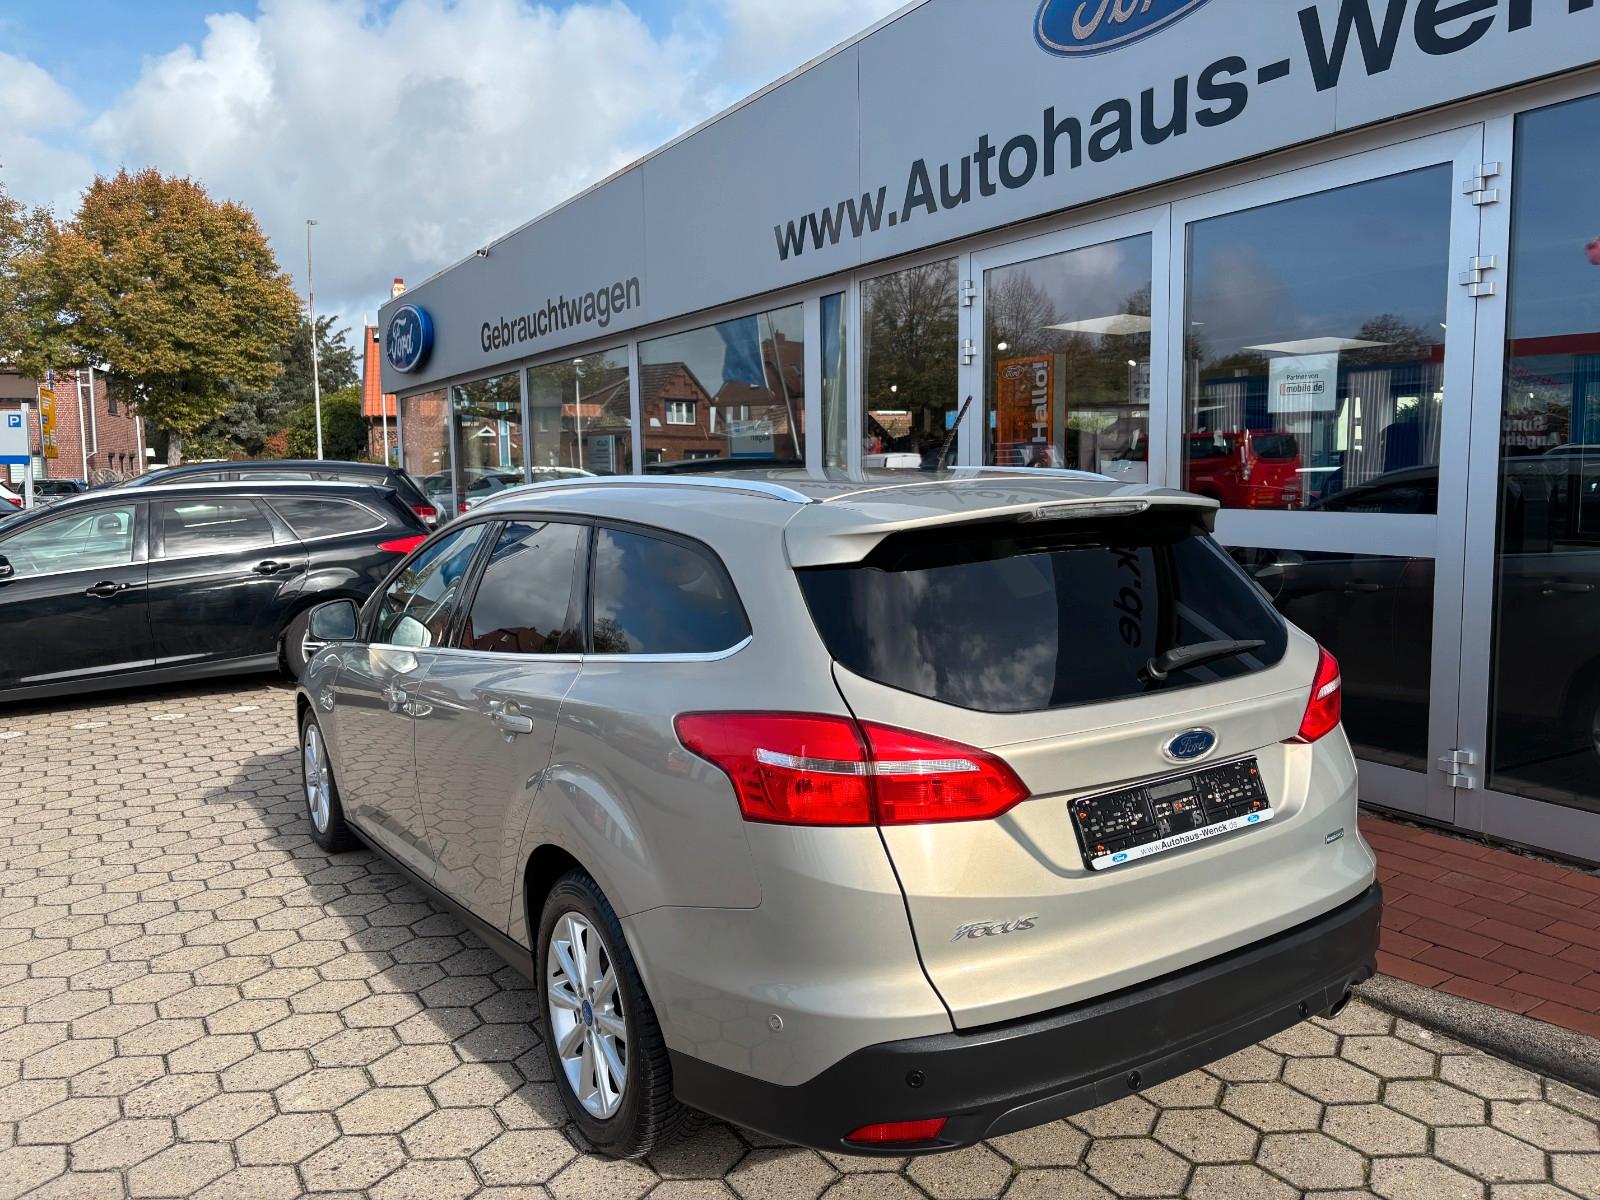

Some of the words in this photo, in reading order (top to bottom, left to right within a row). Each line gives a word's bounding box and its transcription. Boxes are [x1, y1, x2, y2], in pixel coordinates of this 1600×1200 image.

[481, 276, 641, 353] Gebrauchtwagen
[389, 317, 414, 361] Ford
[9, 415, 20, 427] P
[1031, 361, 1048, 443] Hallo!
[1178, 734, 1208, 755] Ford
